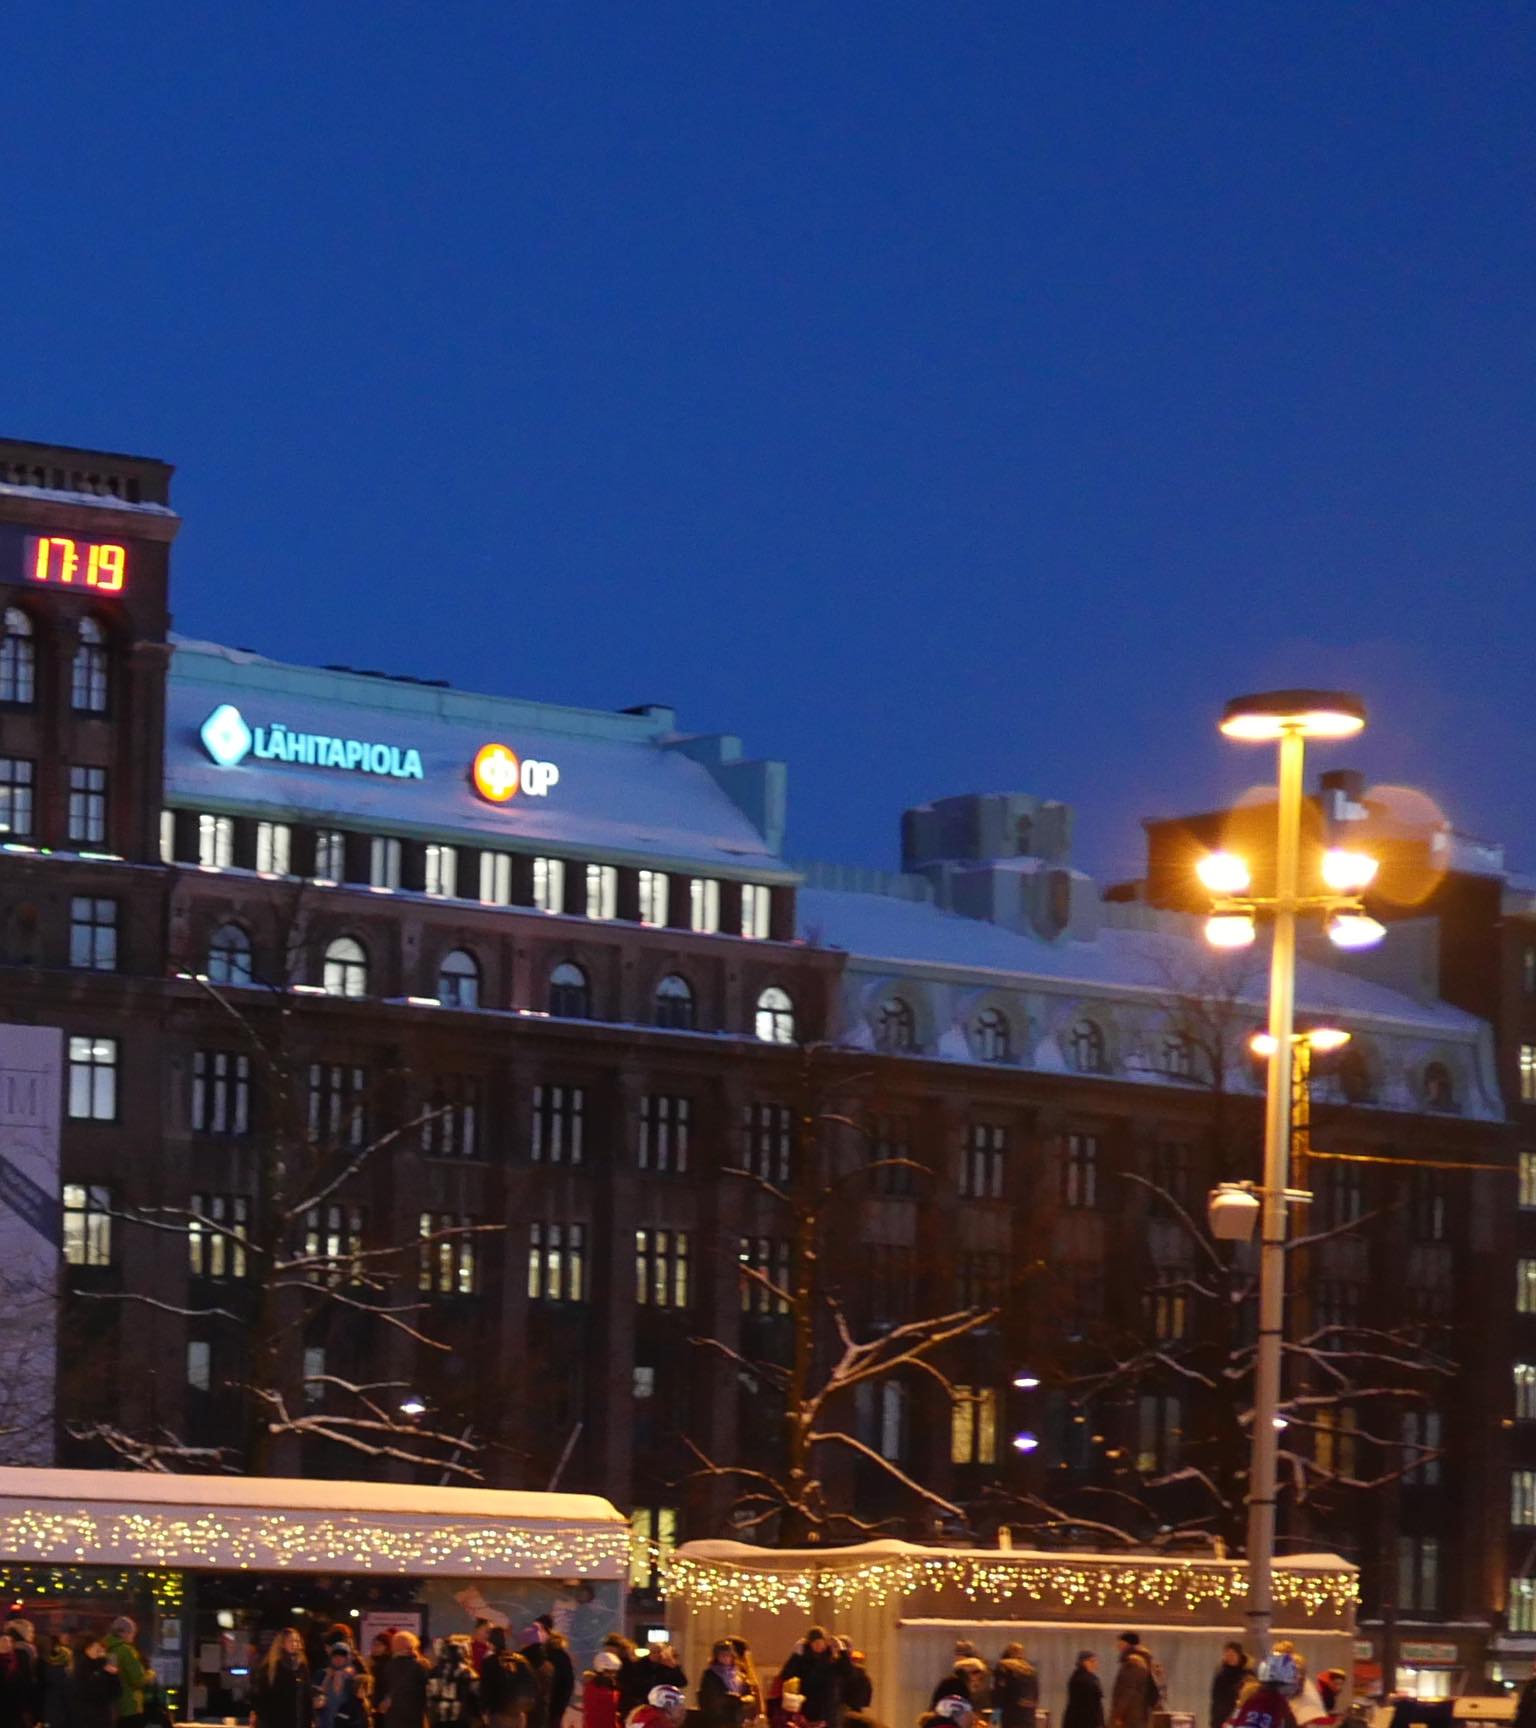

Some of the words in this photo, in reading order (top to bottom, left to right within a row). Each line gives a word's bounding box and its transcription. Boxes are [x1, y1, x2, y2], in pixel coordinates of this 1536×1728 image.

[35, 537, 125, 590] 17:19
[253, 724, 423, 780] LÄHITAPIOLA
[520, 759, 560, 797] OP
